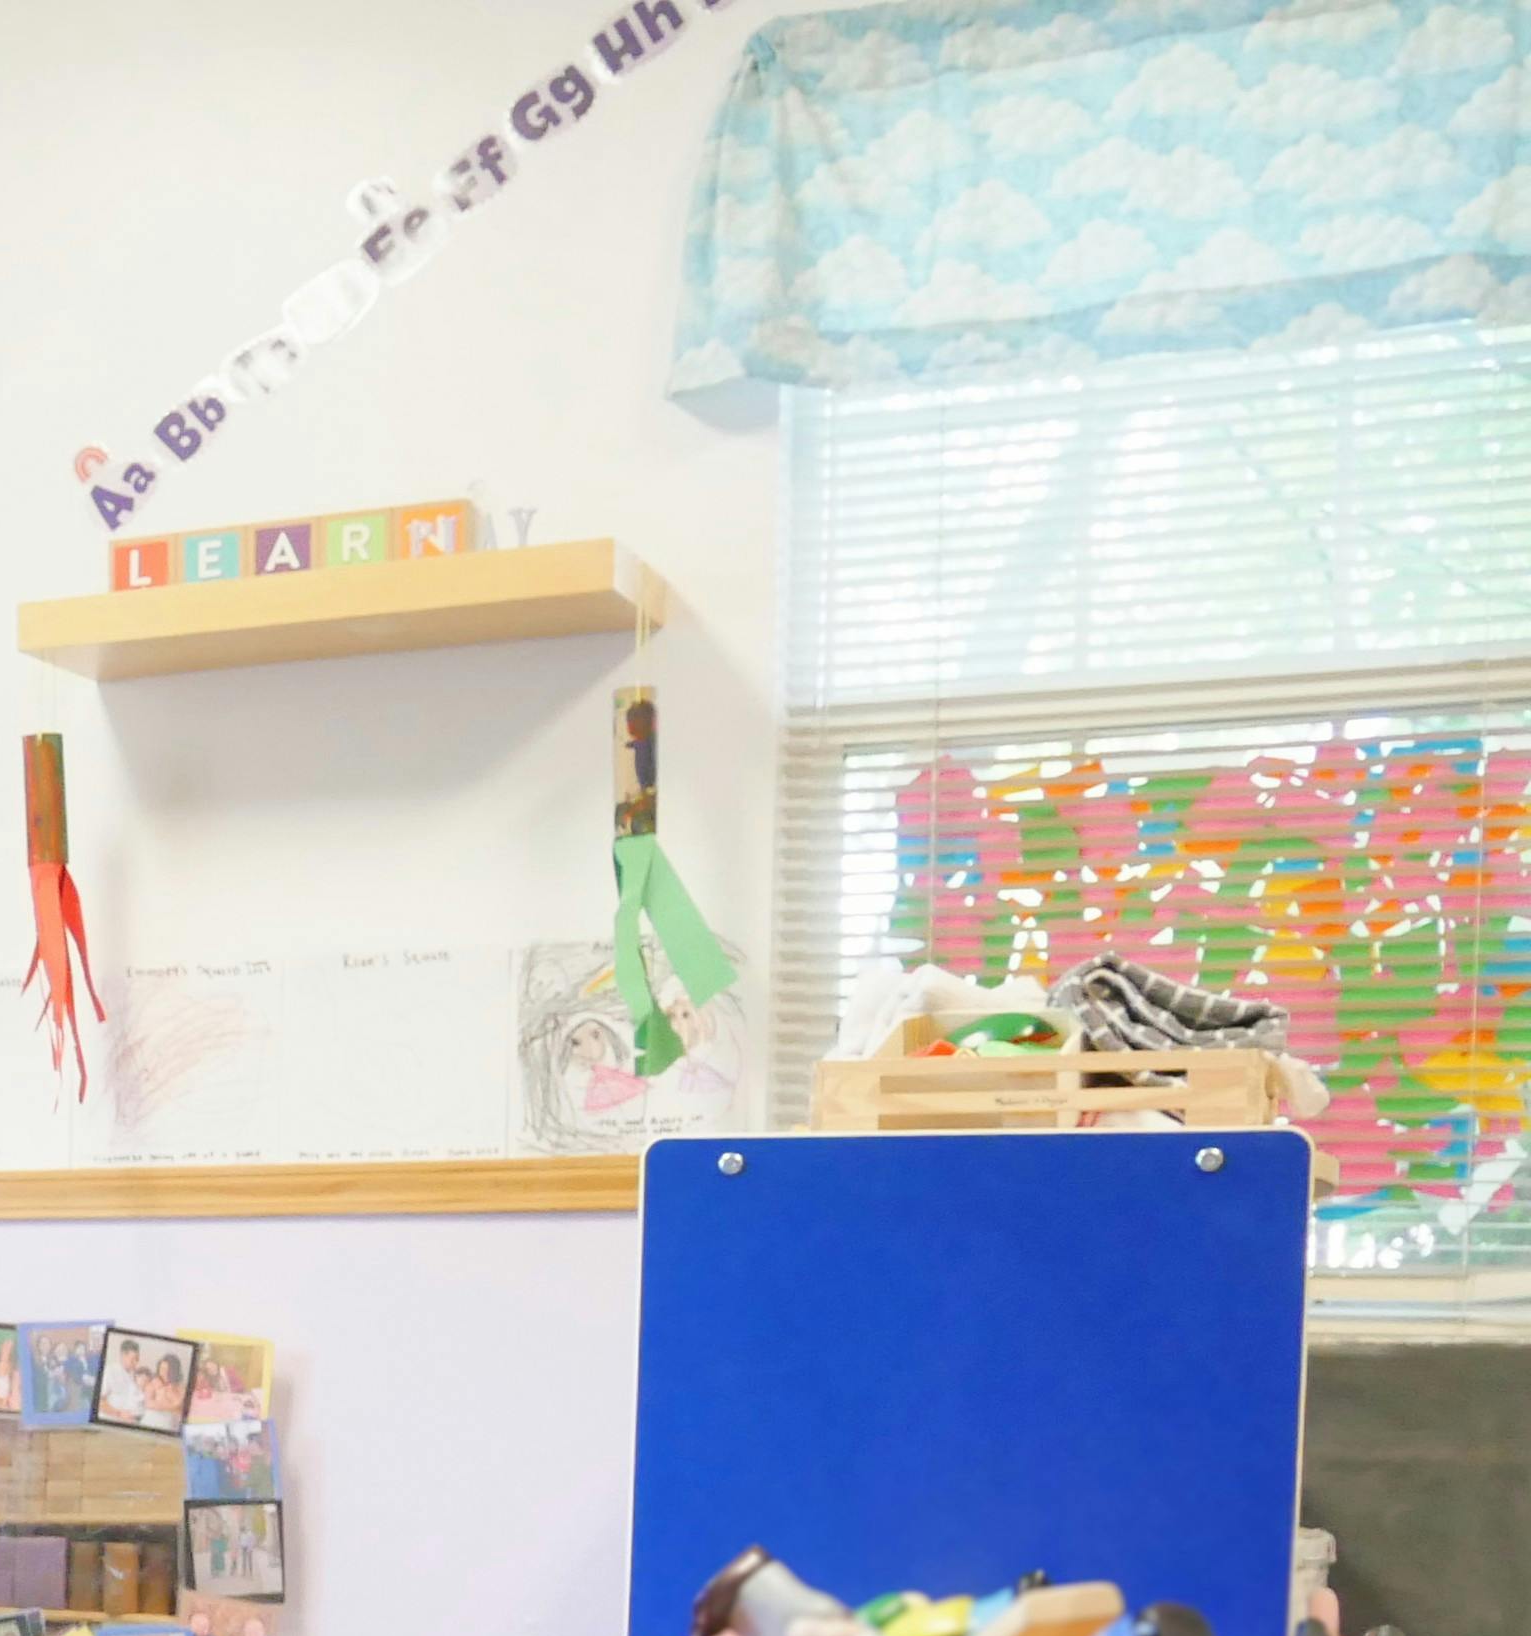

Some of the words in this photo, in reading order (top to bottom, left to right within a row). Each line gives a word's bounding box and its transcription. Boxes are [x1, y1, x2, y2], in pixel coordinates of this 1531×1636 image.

[91, 463, 155, 531] Aa
[154, 397, 226, 461] Bb
[511, 65, 594, 141] Gg
[592, 0, 684, 74] Hh
[128, 513, 460, 588] LEARN
